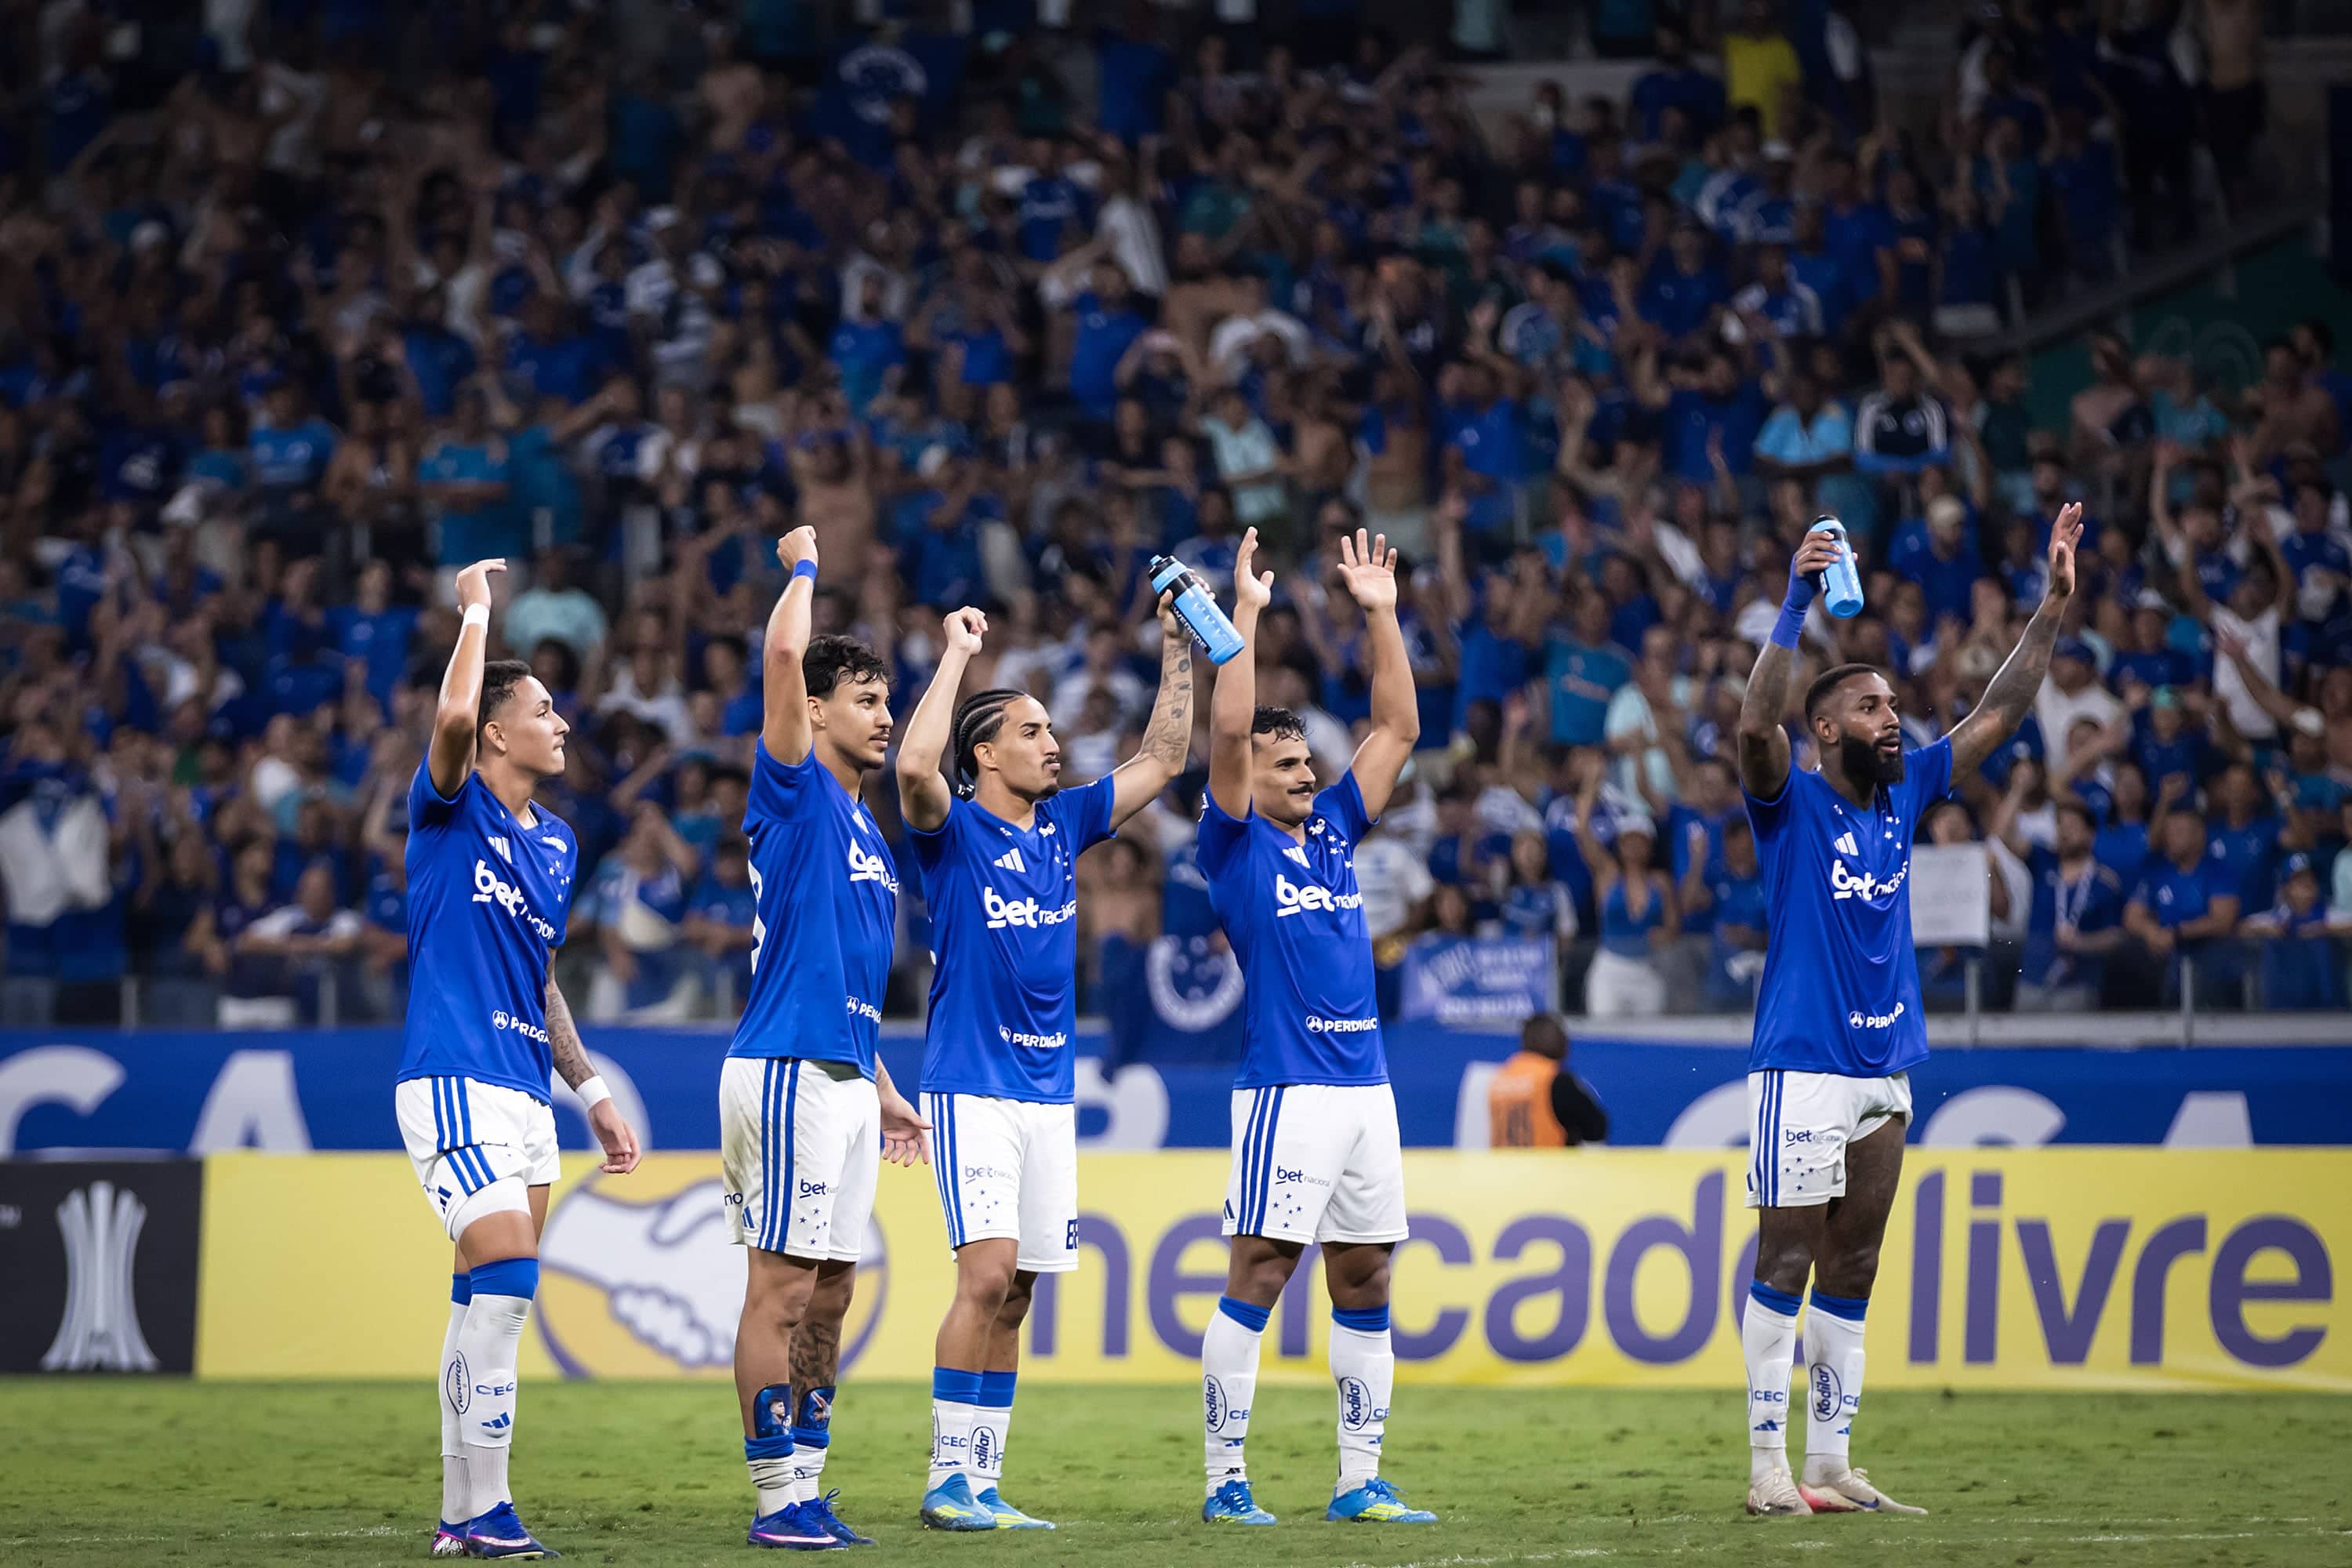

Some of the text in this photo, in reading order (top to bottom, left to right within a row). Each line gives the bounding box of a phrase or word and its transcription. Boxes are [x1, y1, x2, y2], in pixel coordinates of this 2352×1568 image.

[472, 858, 524, 917] bet
[984, 886, 1040, 929] bet
[1276, 873, 1335, 917] bet
[1785, 1128, 1813, 1149] bet
[799, 1178, 827, 1199] bet
[1275, 1165, 1304, 1185] bet
[1908, 1169, 2335, 1369] livre
[1205, 1381, 1218, 1427] Kodilar
[1346, 1380, 1362, 1425] Kodilar
[1754, 1390, 1784, 1402] CEC
[1816, 1367, 1831, 1416] Kodilar
[941, 1436, 967, 1448] CEC
[978, 1430, 990, 1469] odilar
